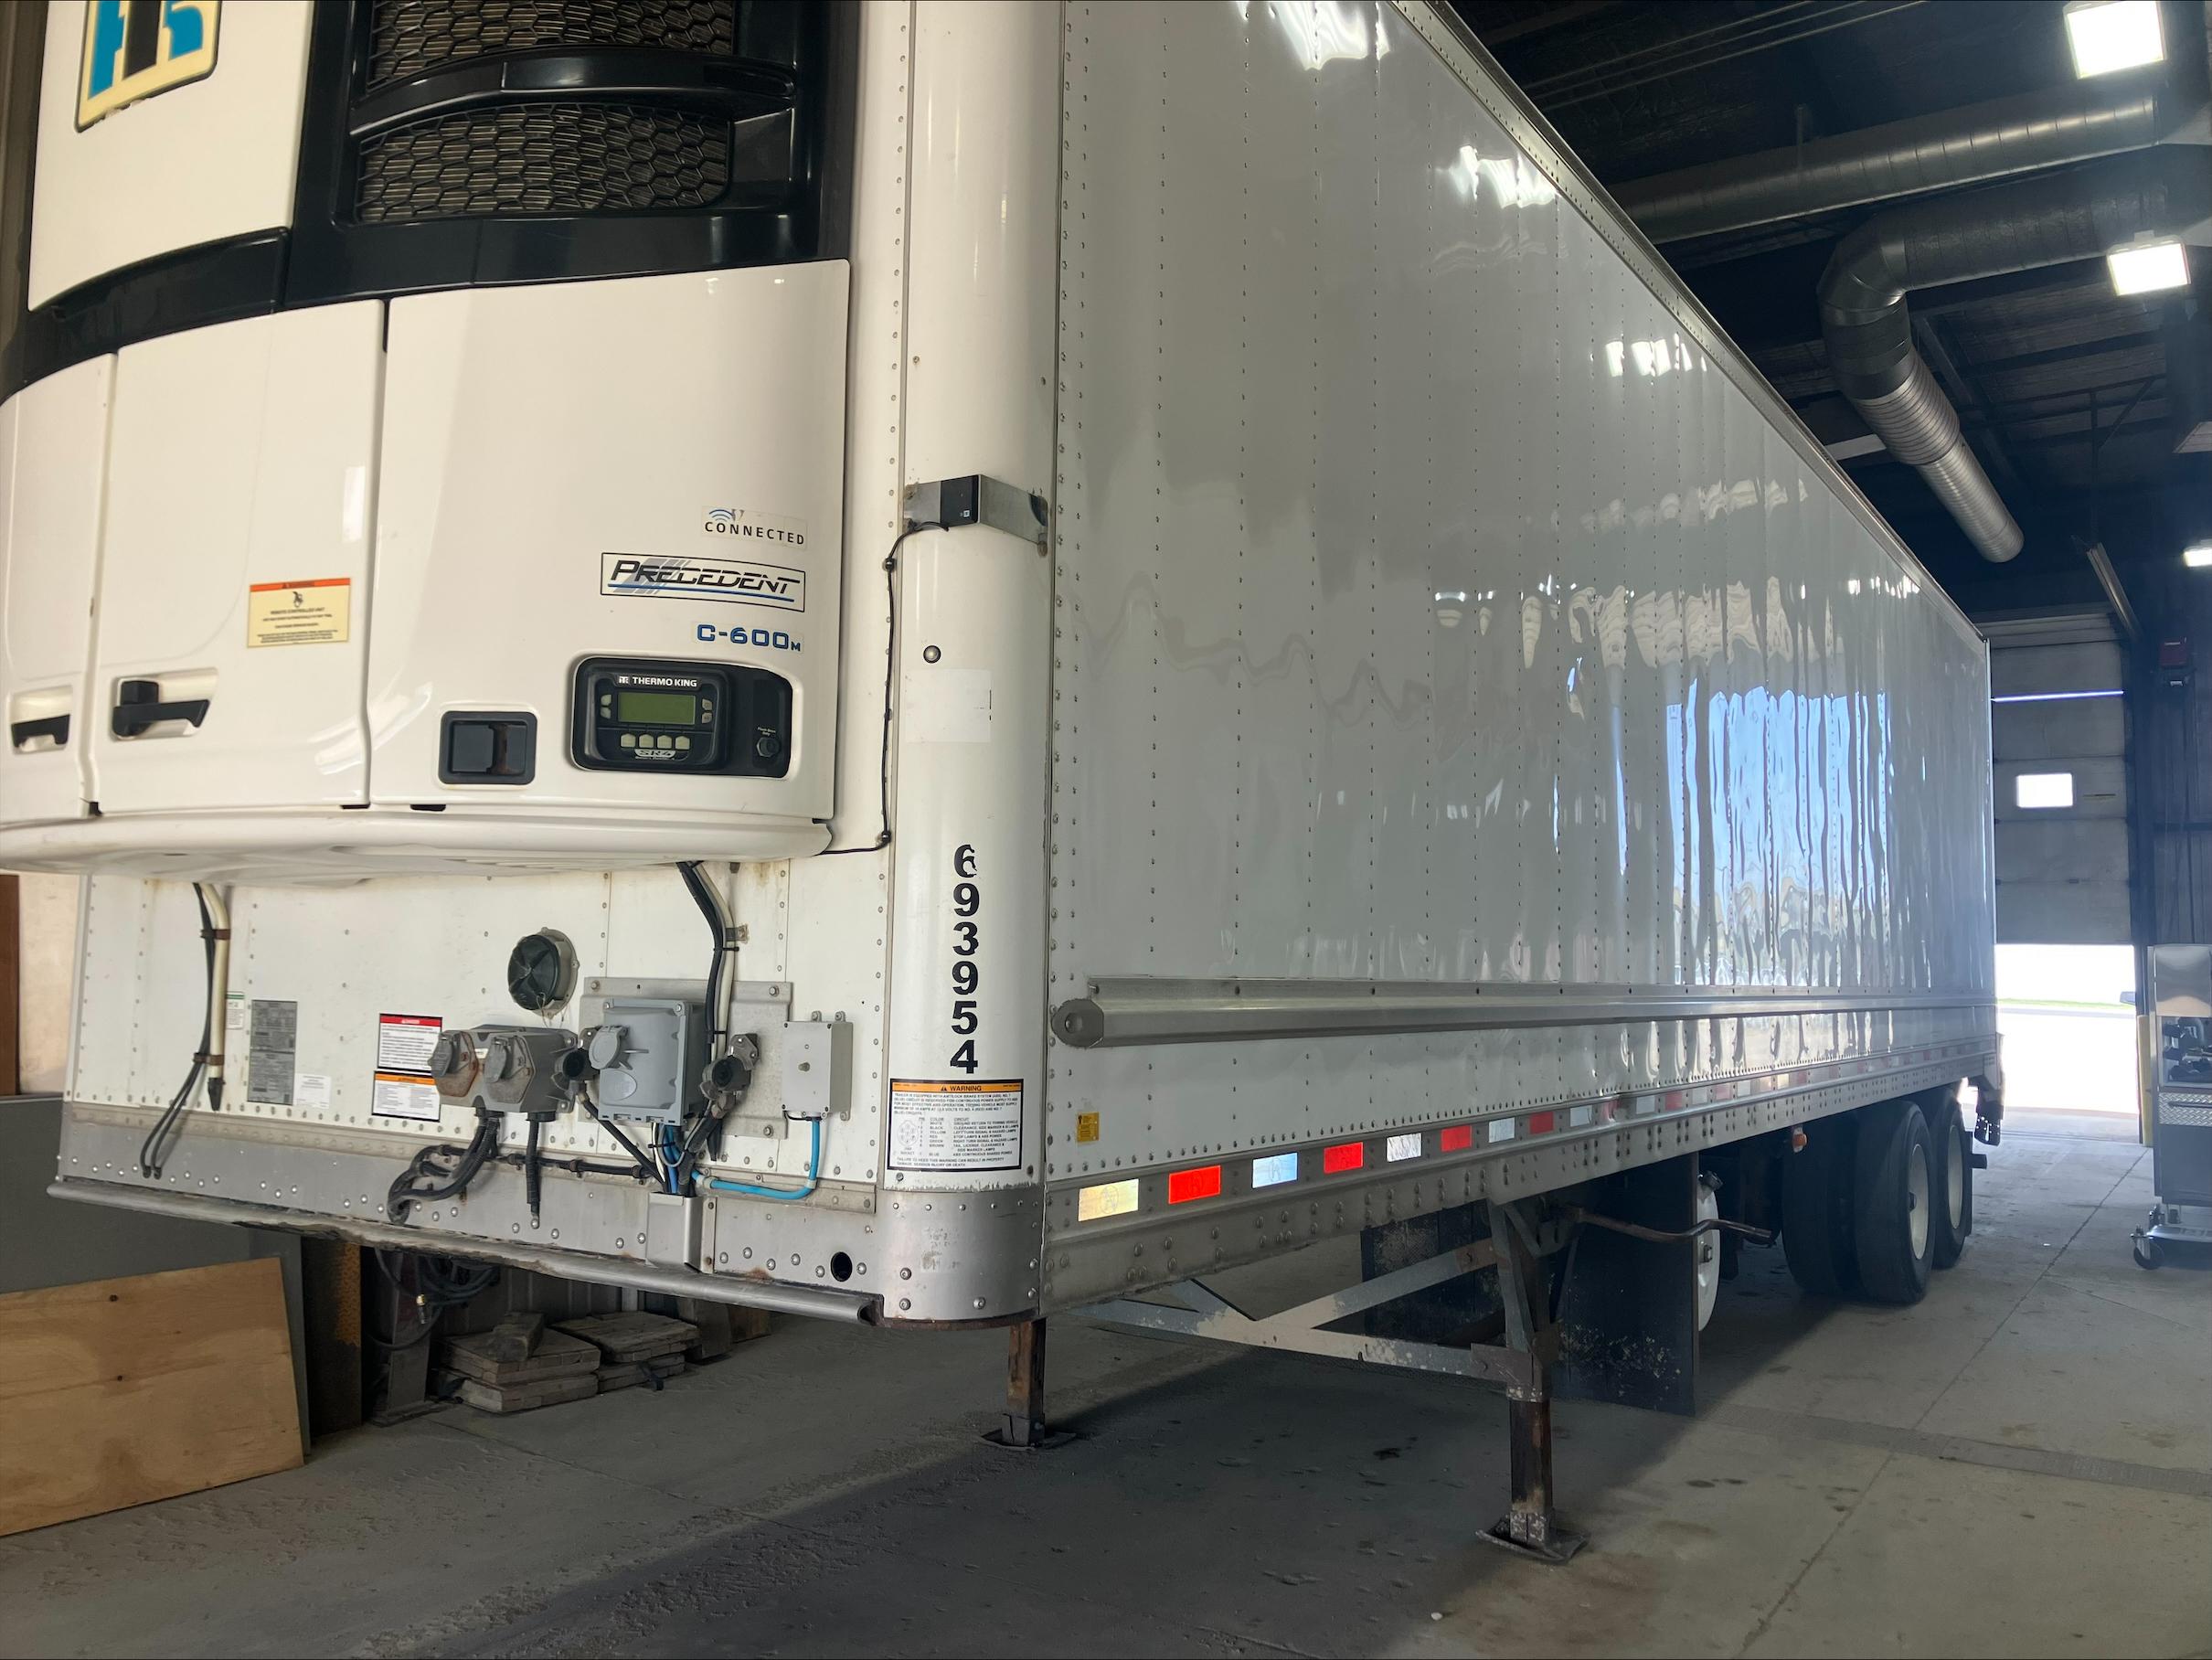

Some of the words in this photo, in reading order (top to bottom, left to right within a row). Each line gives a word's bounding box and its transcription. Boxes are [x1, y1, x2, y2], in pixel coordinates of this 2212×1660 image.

[705, 522, 804, 545] CONNECTED
[611, 559, 801, 594] PRECEDENT
[632, 676, 673, 686] THERMO
[674, 678, 697, 687] KING
[949, 844, 980, 1074] 693954
